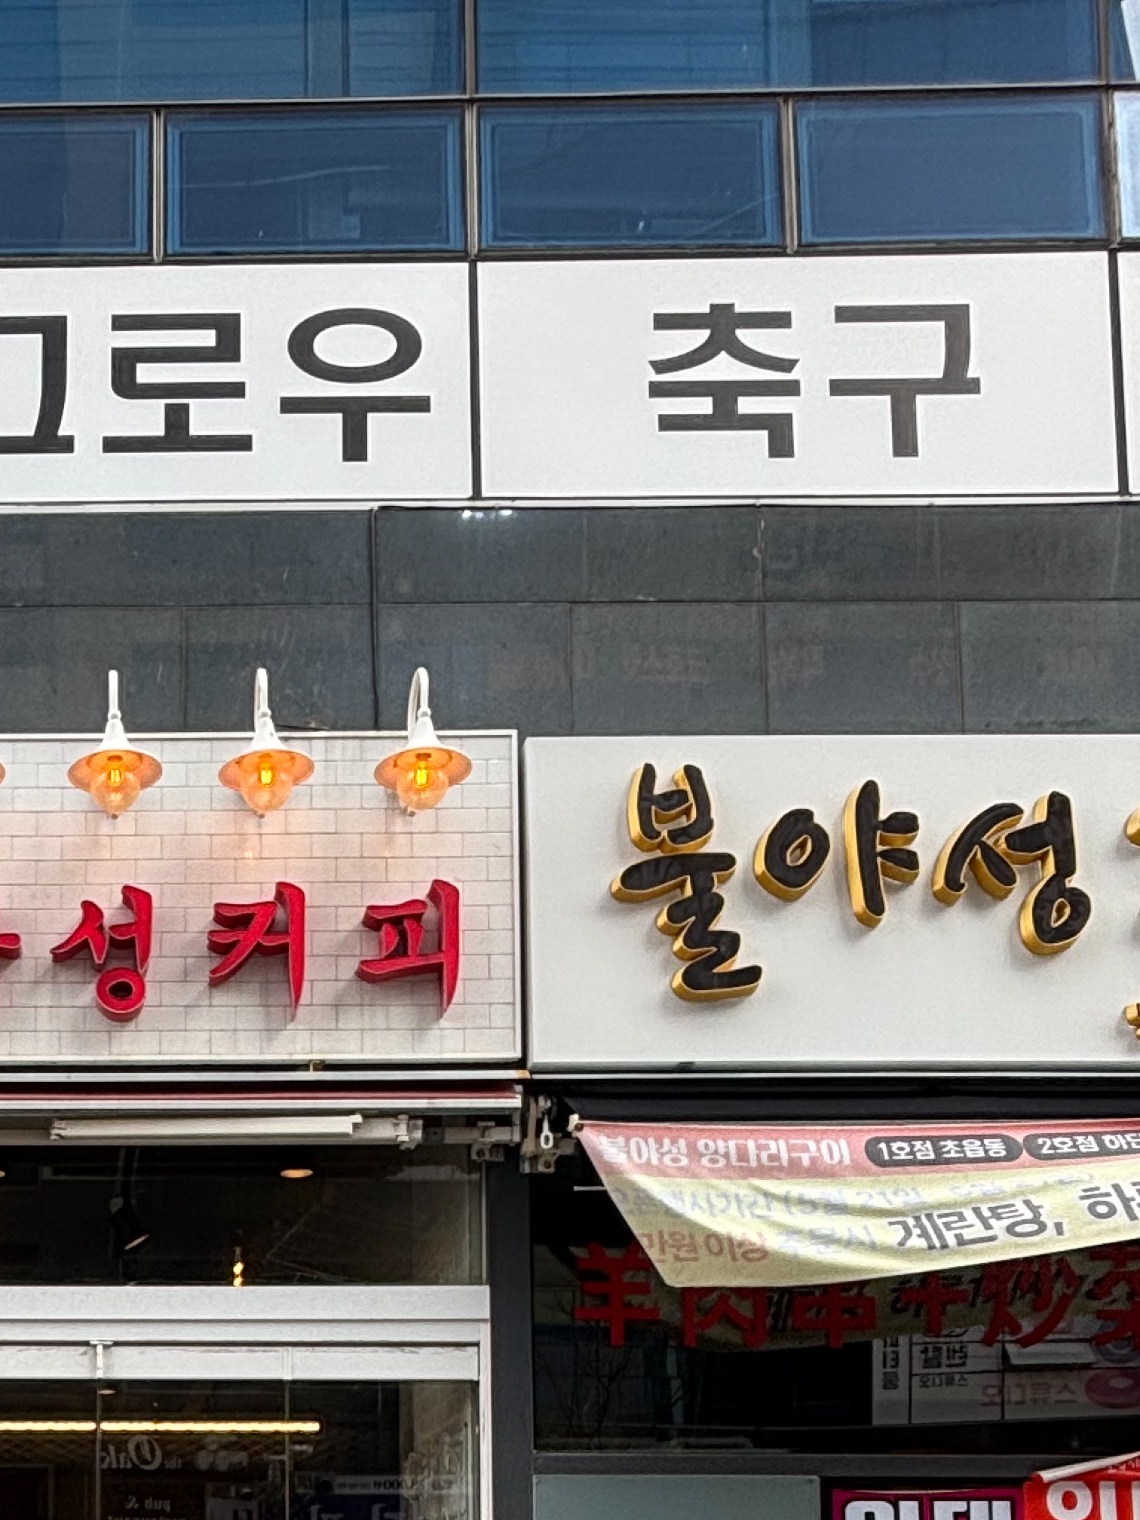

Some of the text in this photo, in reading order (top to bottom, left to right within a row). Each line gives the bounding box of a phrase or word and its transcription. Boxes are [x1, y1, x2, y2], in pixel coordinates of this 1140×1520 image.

[647, 303, 981, 459] 축구
[610, 762, 1091, 1001] 불야성
[697, 1138, 851, 1169] 양다리구이
[877, 1138, 1007, 1161] 1호점 초읍동
[1037, 1133, 1099, 1155] 2호점
[888, 1199, 1066, 1250] 계란탕,
